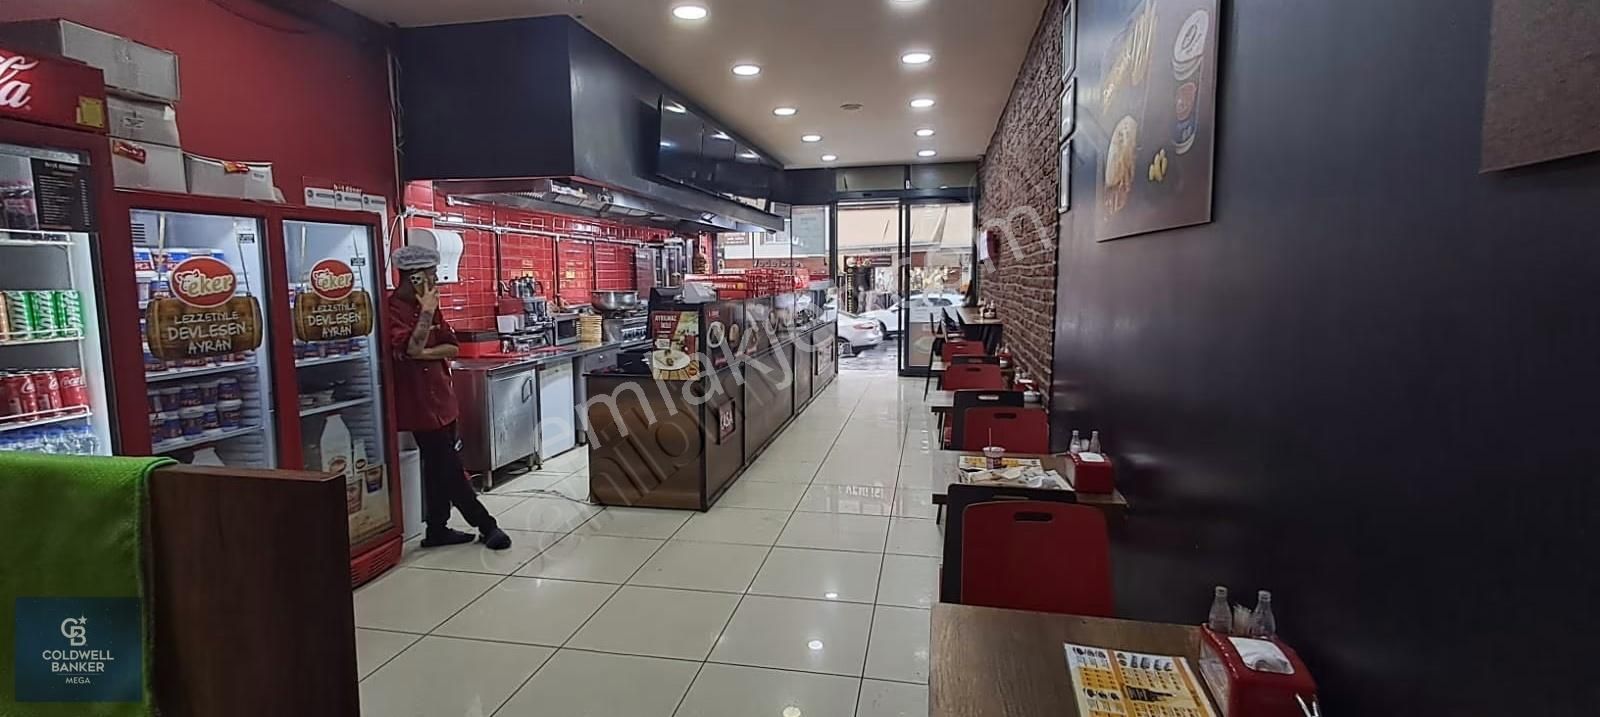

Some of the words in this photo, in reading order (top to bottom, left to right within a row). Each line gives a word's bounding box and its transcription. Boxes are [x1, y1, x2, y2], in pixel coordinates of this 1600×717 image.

[186, 273, 233, 297] eker
[322, 325, 352, 338] AYRAN
[188, 338, 232, 354] AYRAN
